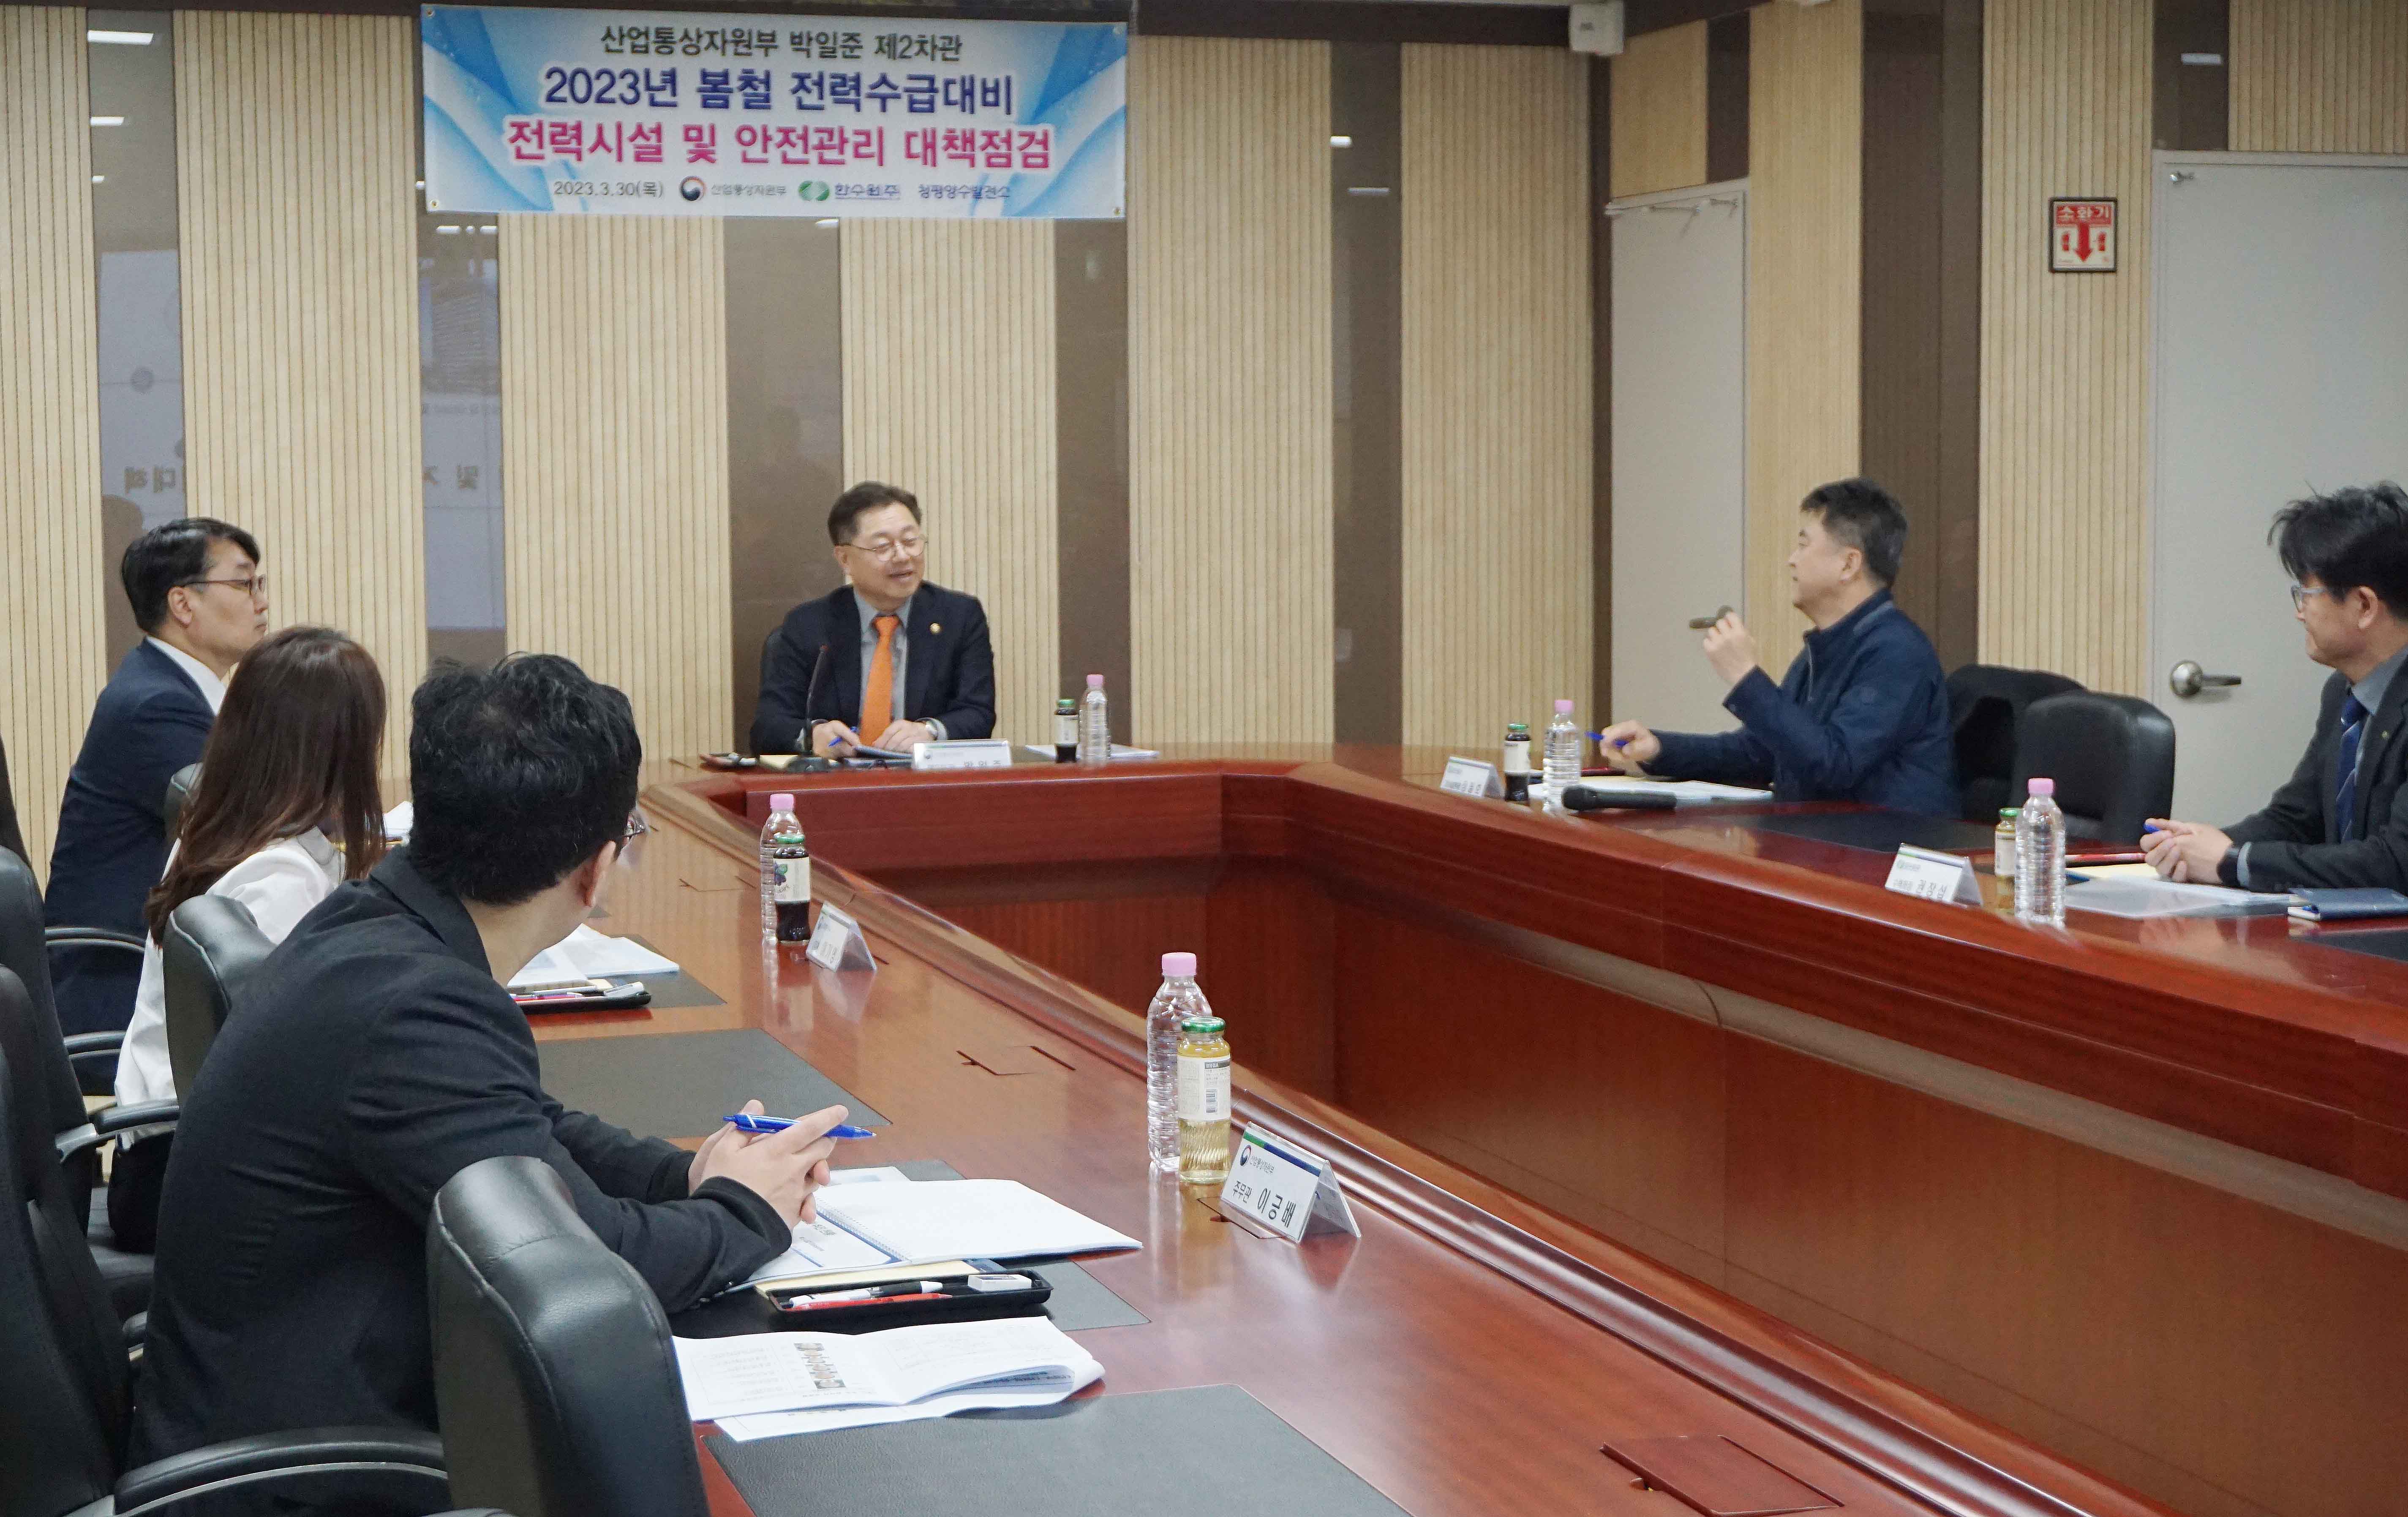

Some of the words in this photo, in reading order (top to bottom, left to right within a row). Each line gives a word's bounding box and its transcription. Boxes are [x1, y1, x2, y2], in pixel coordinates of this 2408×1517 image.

[600, 25, 779, 57] 산업통상자원부
[789, 30, 864, 59] 박일준
[874, 33, 963, 61] 제2차관
[545, 65, 678, 108] 2023년
[695, 68, 773, 110] 봄철
[789, 70, 1012, 115] 전력수급대비
[507, 119, 664, 163] 전력시설
[682, 122, 717, 164] 및
[734, 124, 885, 167] 안전관리
[903, 127, 1050, 169] 대책점검
[553, 180, 665, 198] 2023.3.30(목)
[711, 183, 787, 196] 산업통상자원부
[2057, 205, 2109, 220] 소화기
[1232, 1180, 1253, 1204] 주무관
